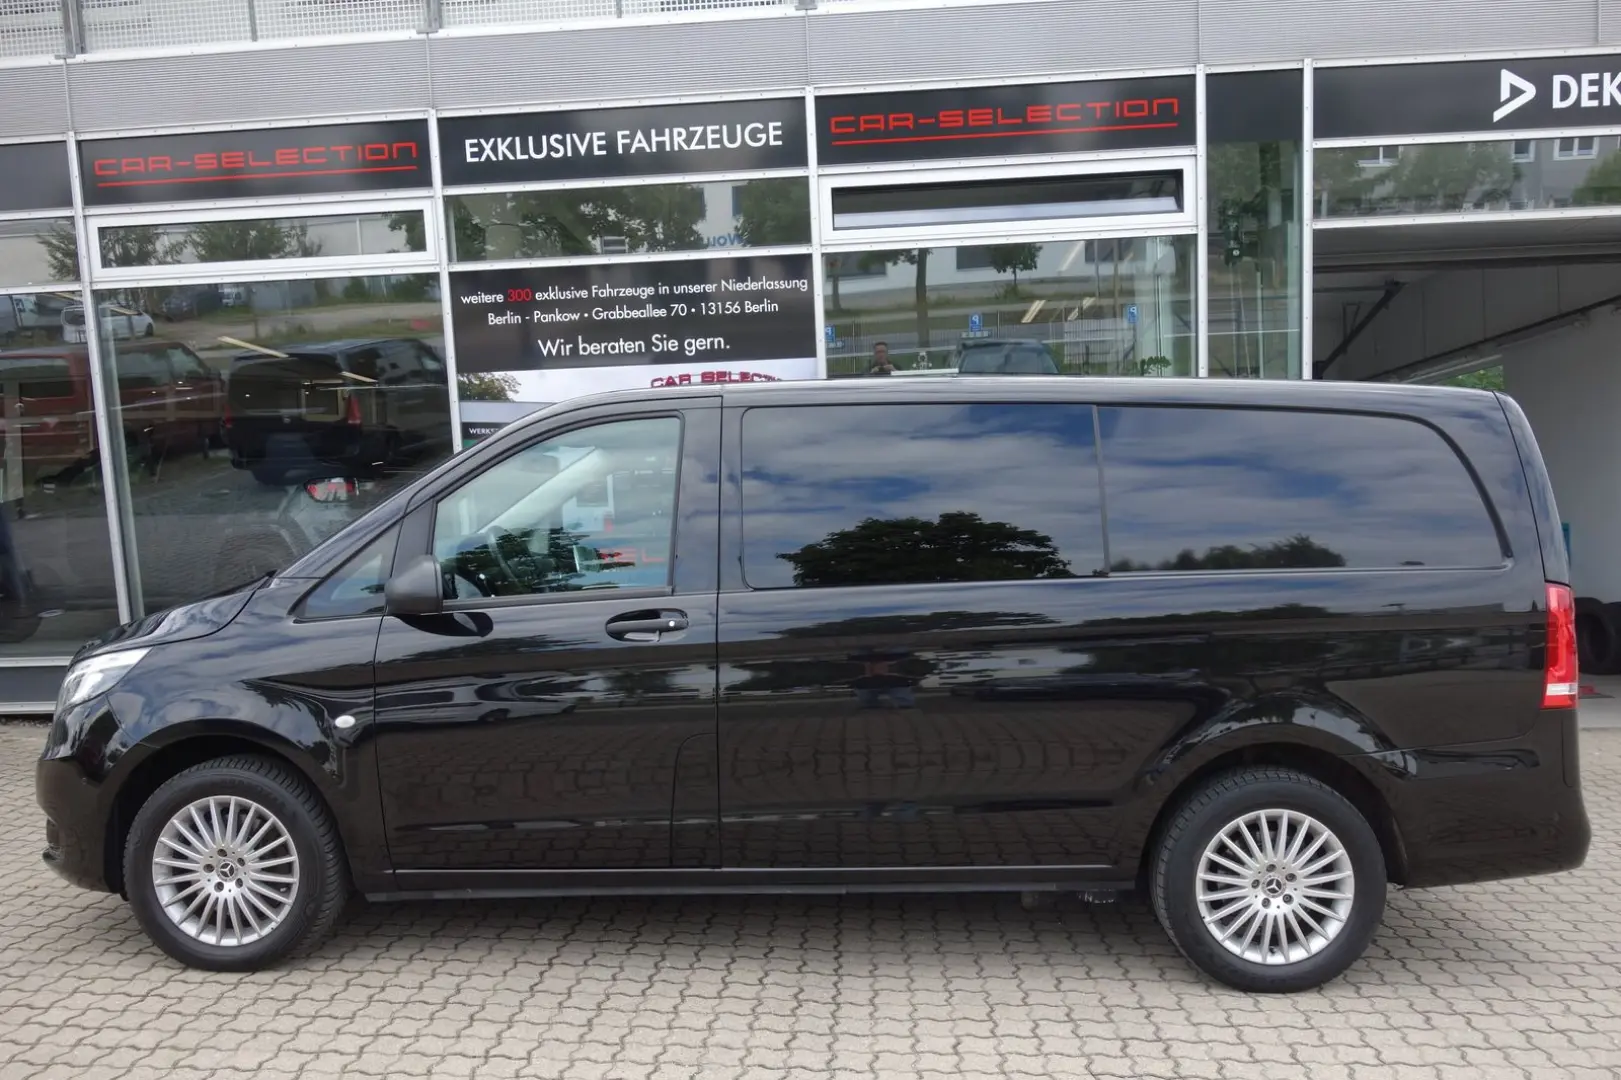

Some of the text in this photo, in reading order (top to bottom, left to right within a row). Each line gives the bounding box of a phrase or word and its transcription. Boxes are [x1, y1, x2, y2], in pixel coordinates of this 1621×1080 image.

[465, 121, 783, 163] EXKLUSIVE FAHRZEUGE
[461, 276, 808, 304] weitere 300 exklusive Fahrzeuge in unserer Niederlassung
[488, 311, 521, 325] Berlin
[533, 308, 580, 323] Pankow
[592, 304, 667, 320] Grabbeallee
[670, 303, 688, 316] 70
[700, 301, 741, 315] 13156
[744, 298, 779, 313] Berlin
[538, 334, 730, 357] Wir beraten Sie gern.
